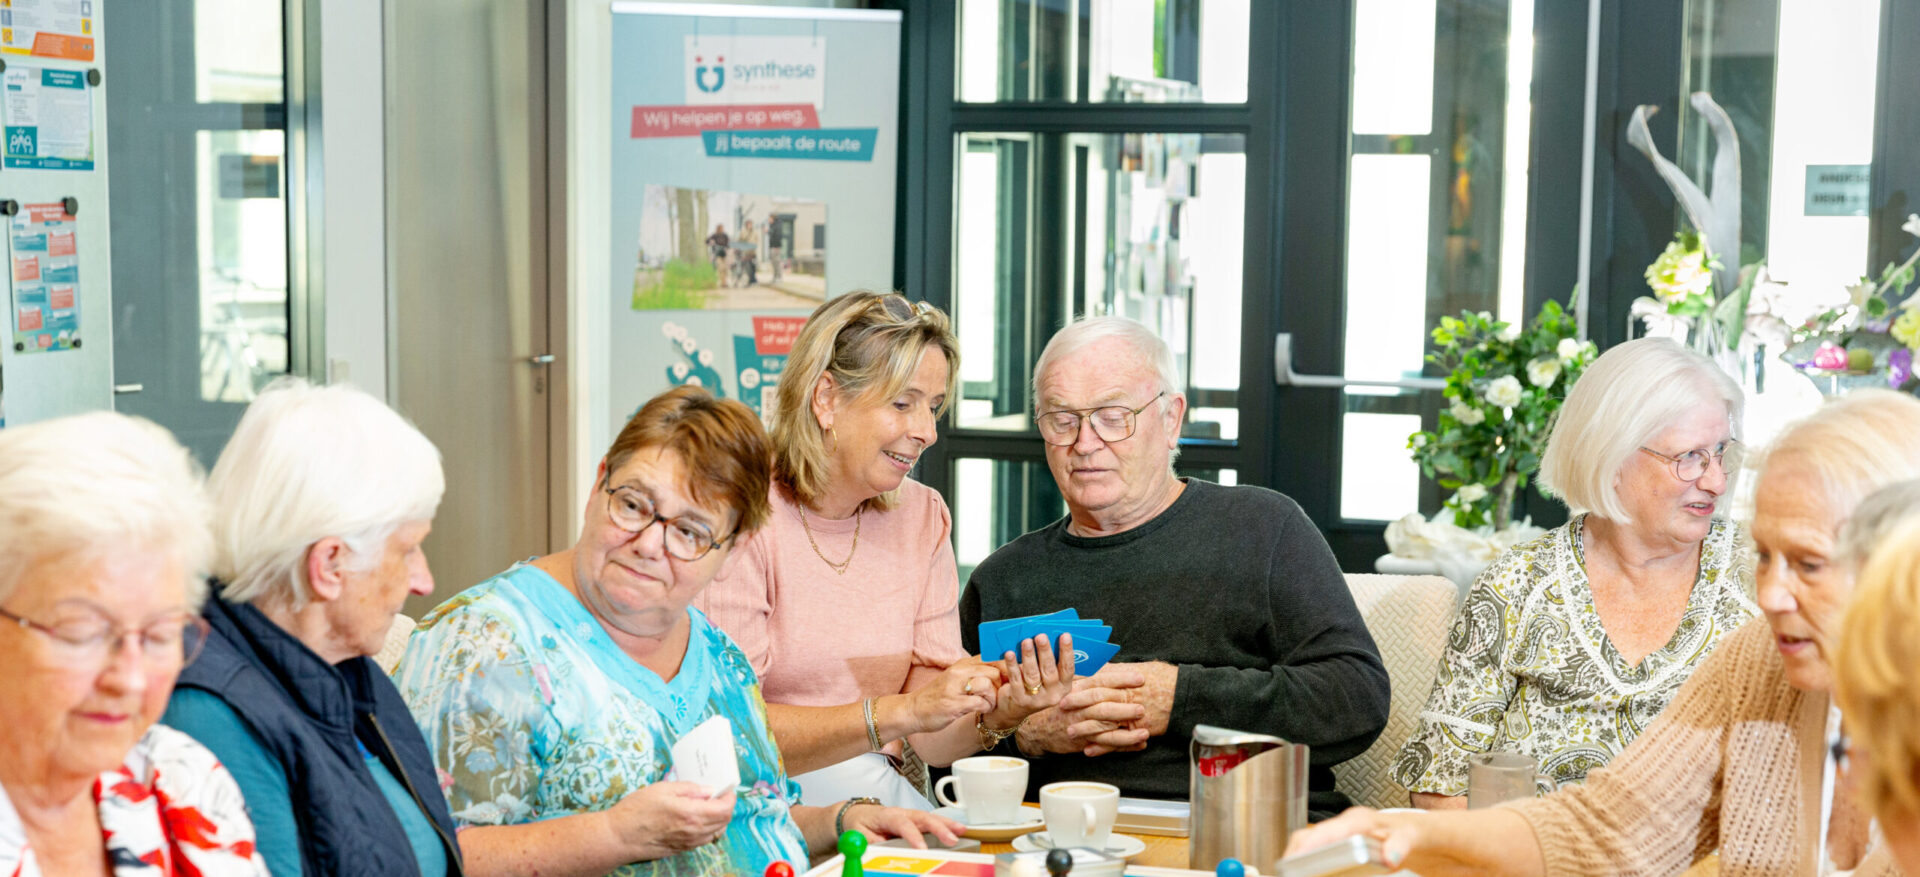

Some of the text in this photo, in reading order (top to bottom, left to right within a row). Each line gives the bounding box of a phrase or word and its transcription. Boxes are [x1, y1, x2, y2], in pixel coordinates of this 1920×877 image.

[733, 61, 816, 82] synthese
[643, 109, 806, 130] Wij helpen je op weg,
[715, 133, 861, 153] jij bepaalt de route
